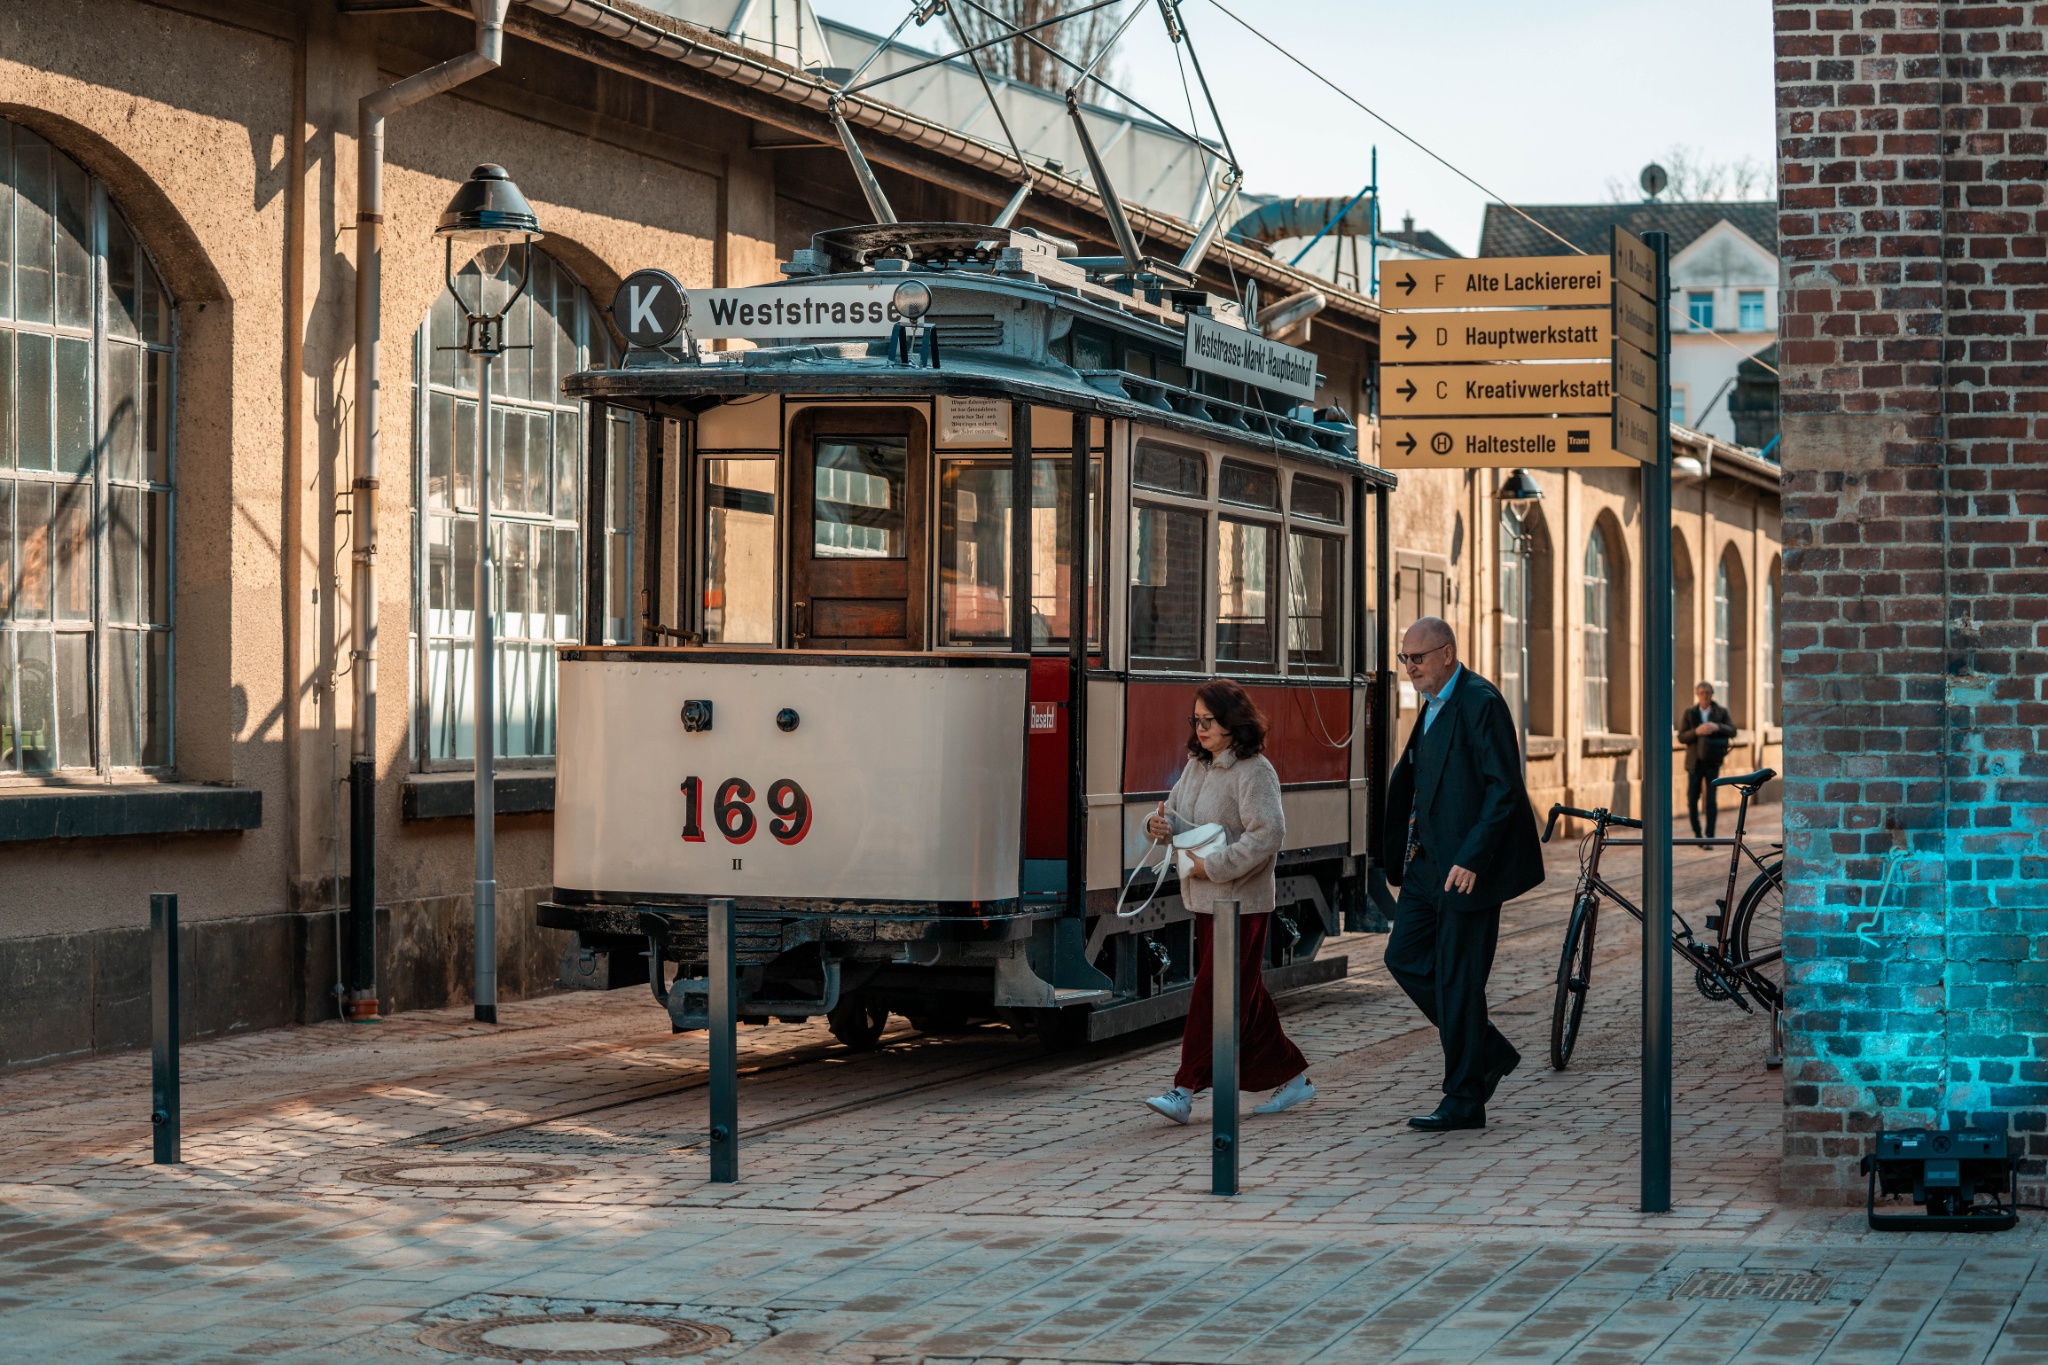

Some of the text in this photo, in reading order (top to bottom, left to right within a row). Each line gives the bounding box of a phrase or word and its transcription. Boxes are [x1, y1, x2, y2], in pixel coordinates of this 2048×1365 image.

[1435, 270, 1601, 293] F Alte Lackiererei
[630, 285, 663, 333] K
[709, 297, 901, 326] Weststrasse
[1436, 325, 1598, 350] D Hauptwerkstatt
[1436, 379, 1610, 400] C Kreativwerkstatt
[1466, 434, 1556, 454] Haltestelle
[1568, 436, 1589, 445] Tram
[1031, 705, 1055, 729] Besetzt
[681, 776, 812, 845] 169
